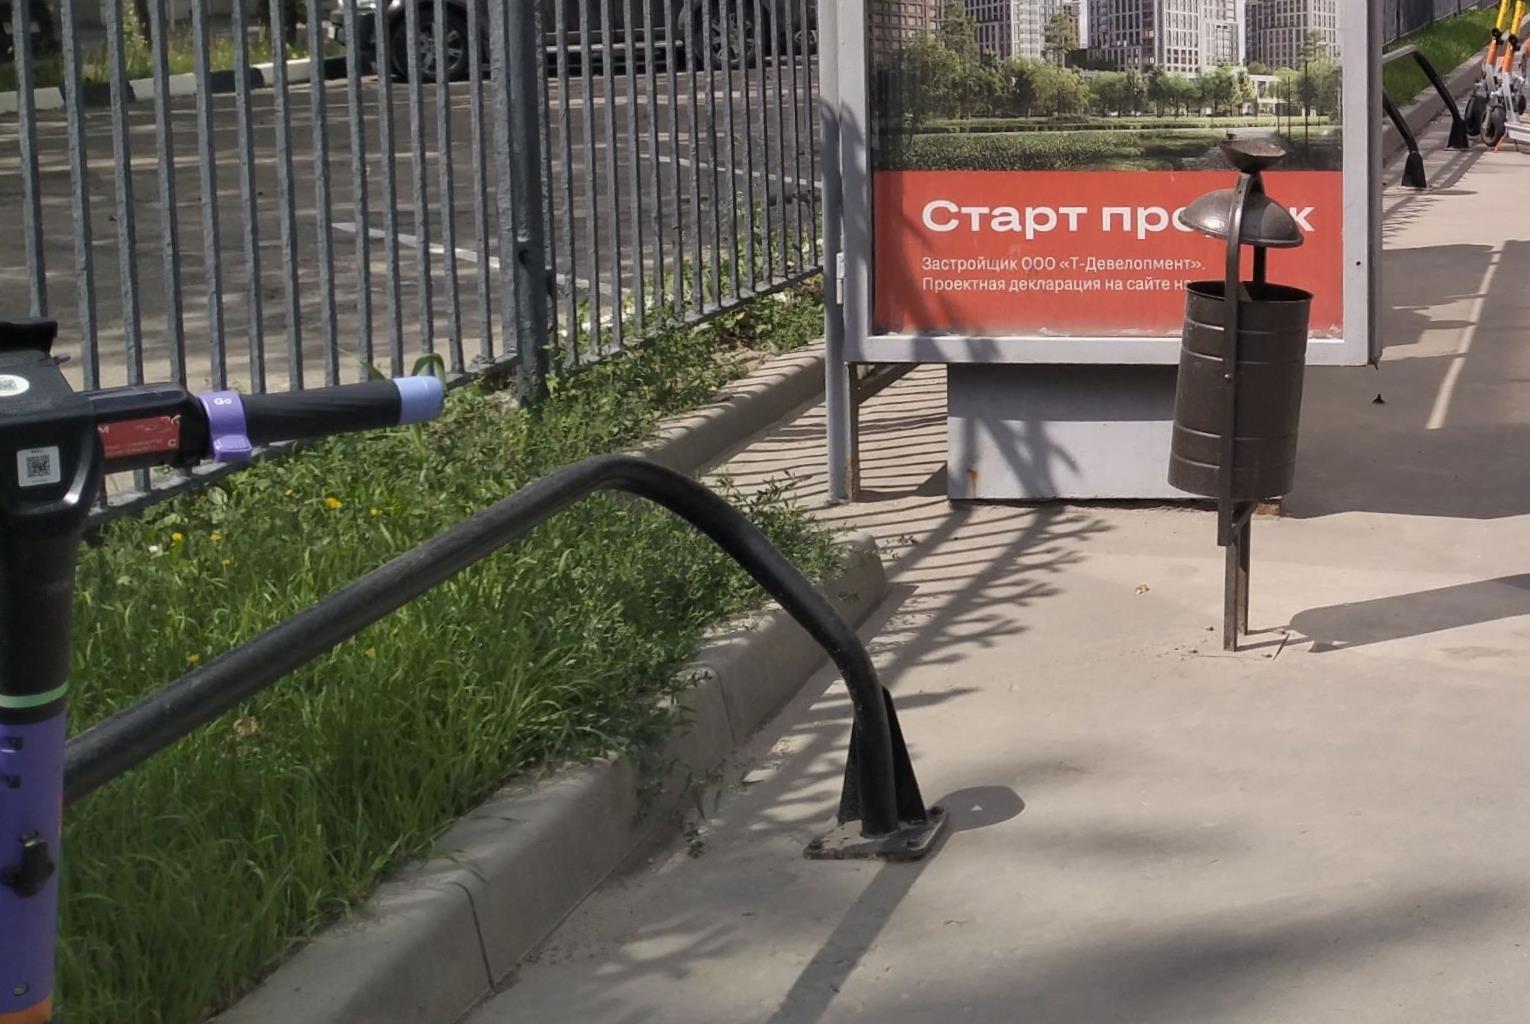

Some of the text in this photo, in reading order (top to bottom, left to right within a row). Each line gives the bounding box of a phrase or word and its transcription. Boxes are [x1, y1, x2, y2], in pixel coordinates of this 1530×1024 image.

[922, 200, 1088, 239] Старт
[922, 256, 1018, 273] Застройщик
[1021, 256, 1056, 271] ООО
[922, 277, 1006, 293] Проектная
[1009, 277, 1101, 293] декларация
[1105, 279, 1123, 291] на
[1130, 276, 1170, 291] сайте
